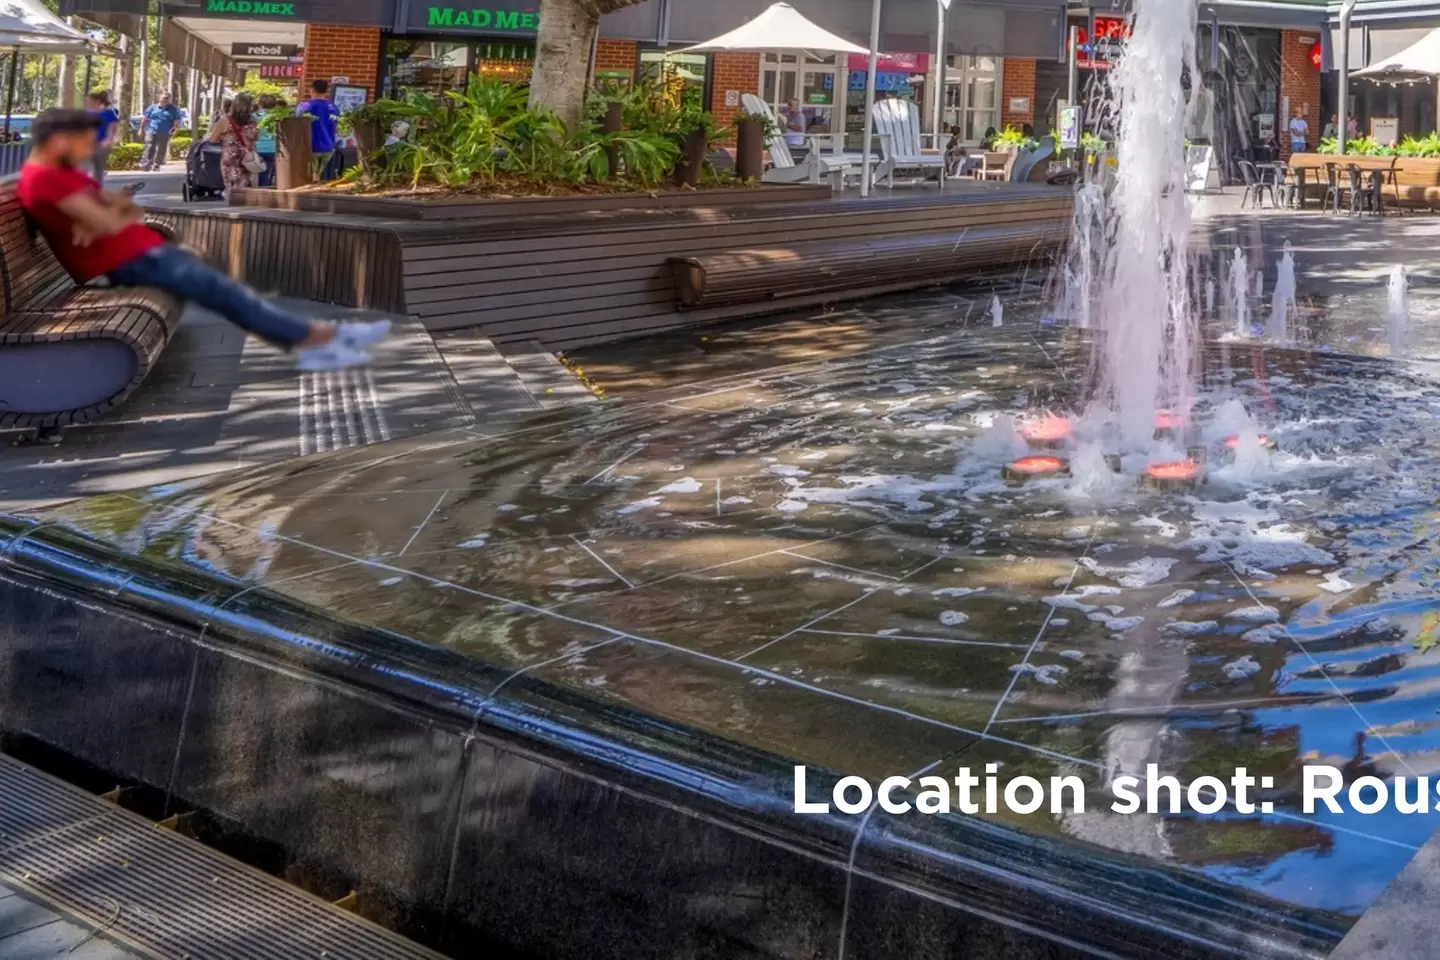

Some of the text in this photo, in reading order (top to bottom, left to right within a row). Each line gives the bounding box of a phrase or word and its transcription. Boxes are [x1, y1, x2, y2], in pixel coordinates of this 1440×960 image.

[207, 0, 295, 16] MAD MEX
[427, 7, 491, 28] MAD
[247, 45, 282, 56] rebel
